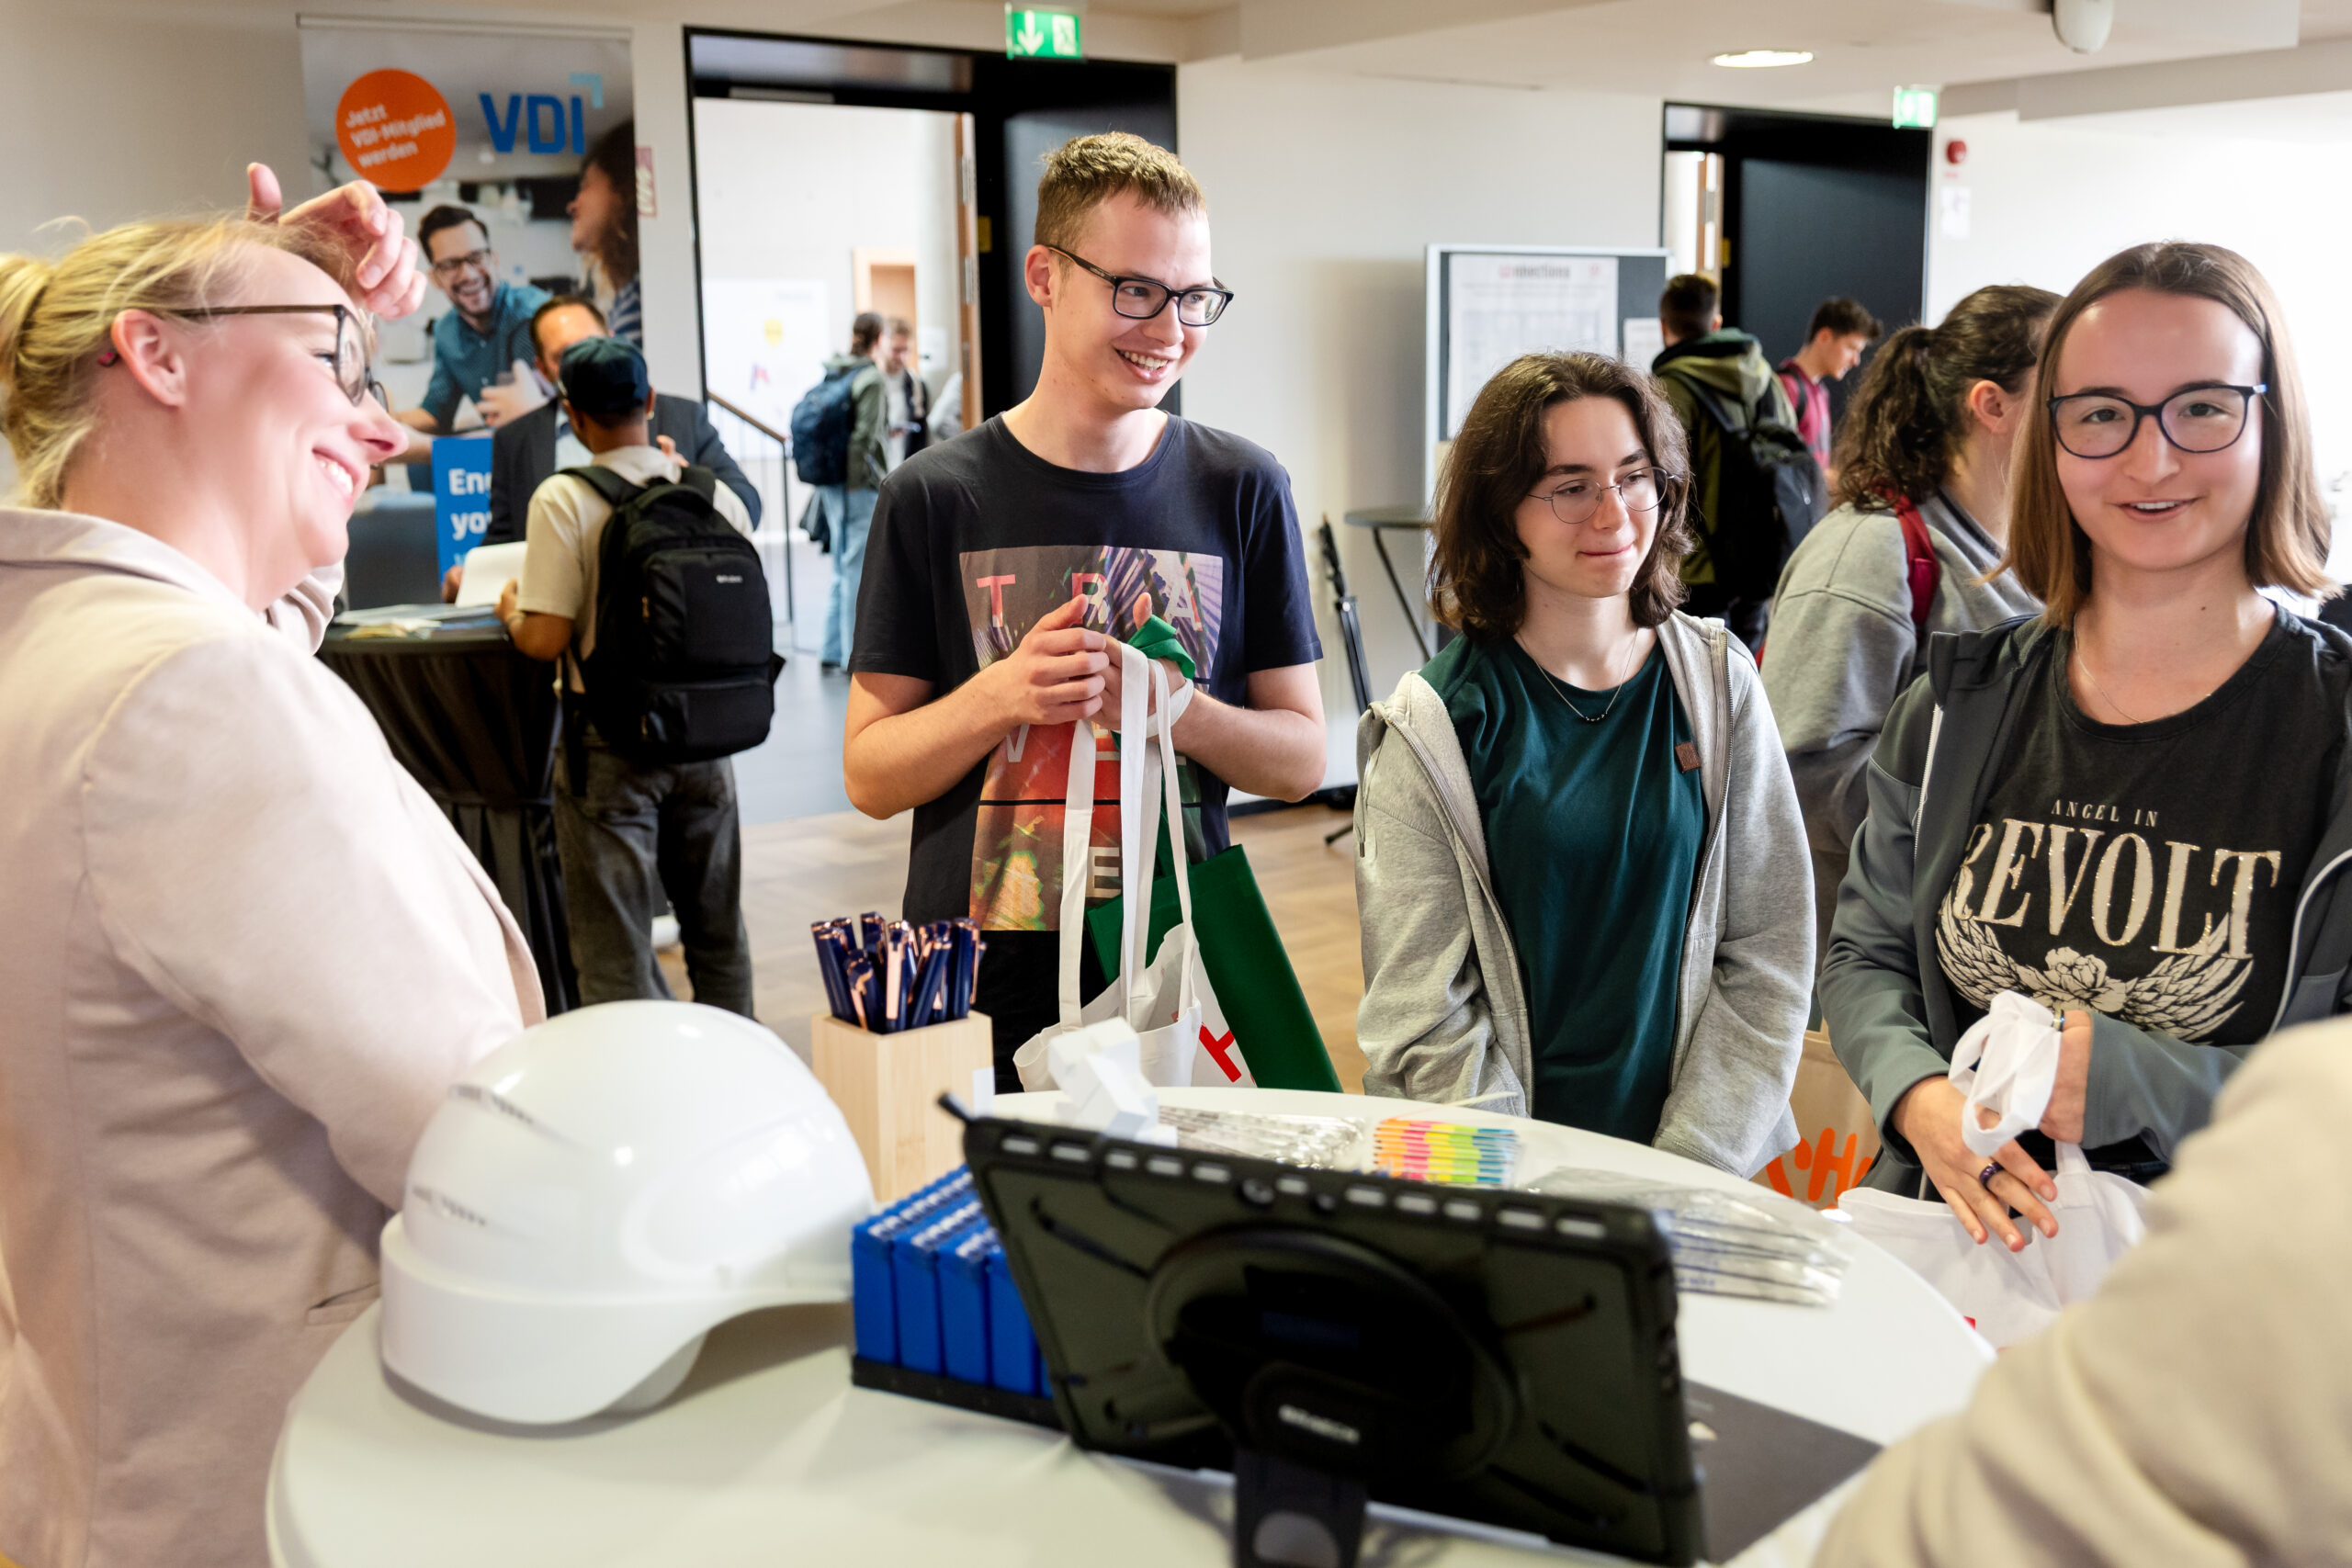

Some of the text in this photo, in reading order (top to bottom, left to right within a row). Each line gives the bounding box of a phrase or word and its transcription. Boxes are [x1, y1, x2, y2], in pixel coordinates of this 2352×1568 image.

[345, 103, 388, 128] Jetzt
[350, 108, 446, 148] VDI-Mitglied
[479, 93, 585, 154] VDI
[358, 141, 419, 168] werden
[2051, 799, 2158, 827] ANGEL IN
[1940, 818, 2281, 960] REVOLT
